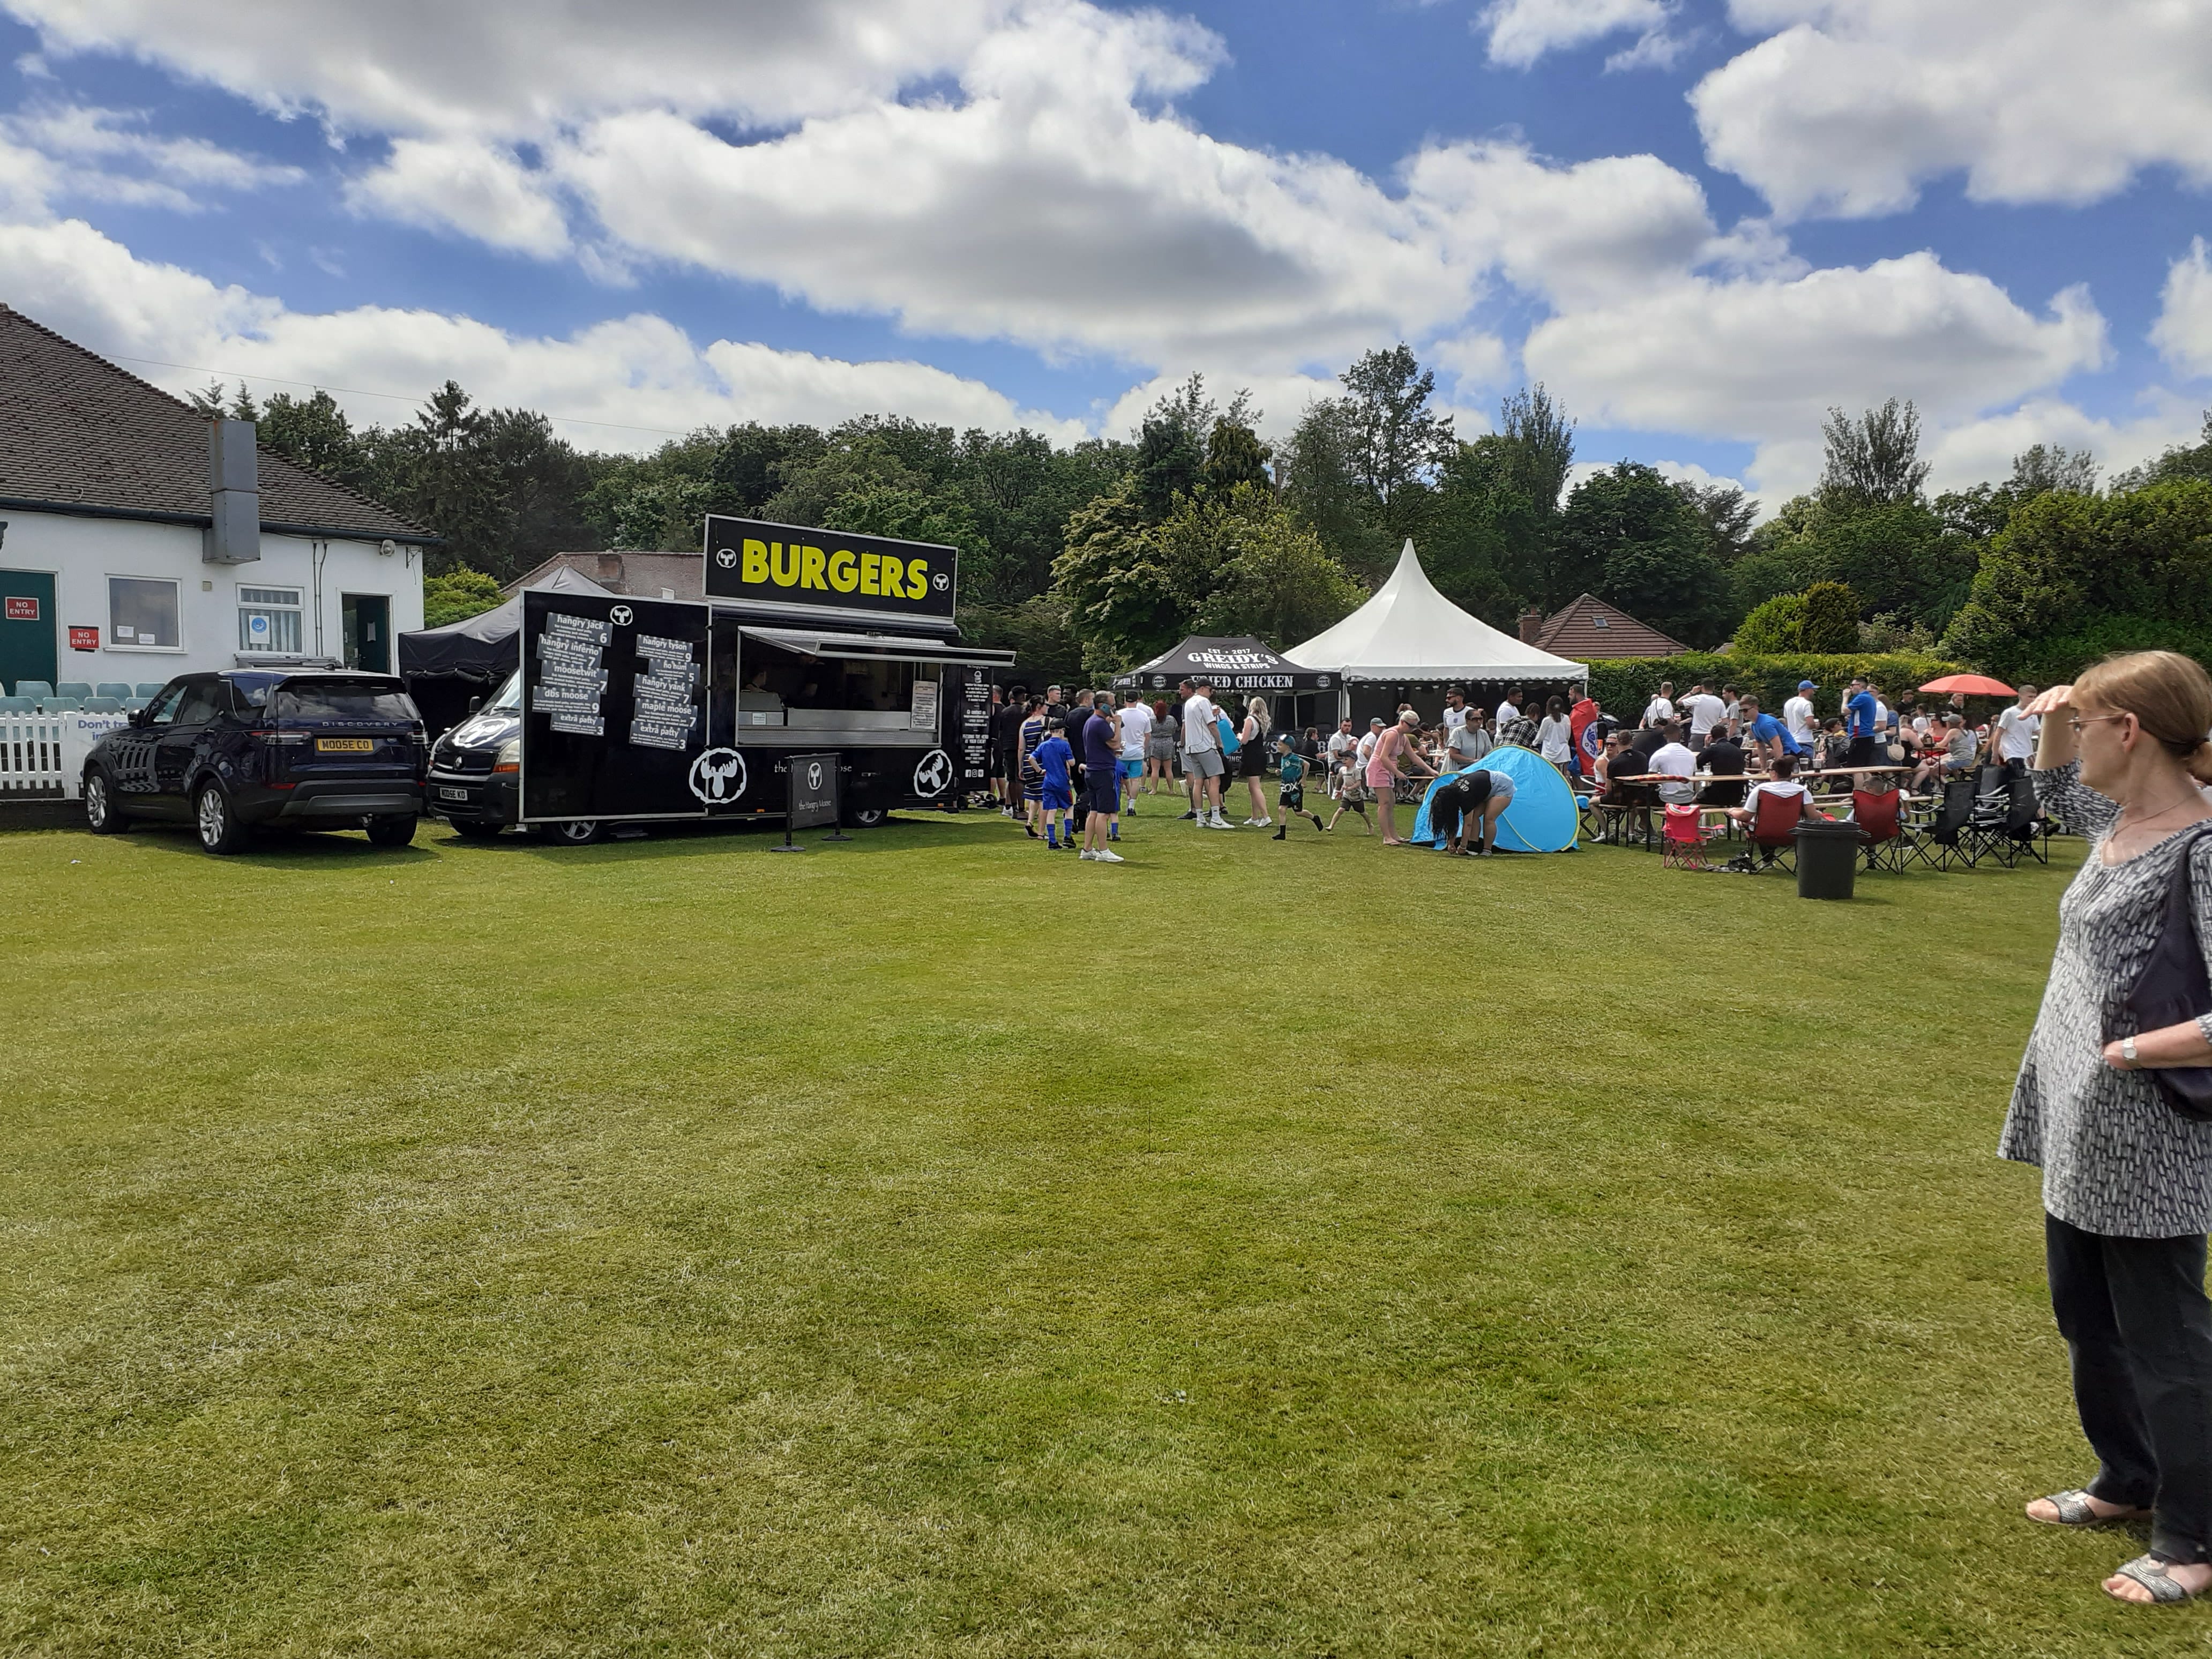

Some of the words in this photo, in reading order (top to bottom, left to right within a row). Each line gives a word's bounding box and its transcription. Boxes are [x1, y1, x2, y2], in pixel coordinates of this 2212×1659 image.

[742, 539, 928, 600] BURGERS
[557, 615, 585, 628] hangry
[587, 620, 604, 630] jack
[600, 633, 607, 644] 6
[642, 637, 668, 648] hangry
[668, 640, 687, 651] tyson
[541, 636, 570, 650] hangry
[571, 642, 599, 655] inferno
[588, 656, 595, 667] 7
[685, 653, 692, 662] 9
[554, 666, 597, 677] moosetwit
[672, 662, 687, 670] hum
[688, 672, 694, 682] 5
[1191, 675, 1231, 687] FIED
[1235, 675, 1294, 688] CHICKEN
[600, 681, 607, 691] 7
[642, 677, 668, 689] hangry
[668, 682, 685, 692] yank
[544, 689, 559, 698] dbs
[683, 694, 690, 704] 7
[592, 703, 600, 714] 9
[642, 703, 666, 712] maple
[667, 706, 692, 715] moose
[78, 720, 110, 729] Don't
[579, 715, 596, 725] patty
[690, 717, 696, 727] 7
[597, 727, 604, 735] 3
[640, 725, 659, 734] extra
[660, 727, 679, 738] patty
[679, 739, 686, 749] 3
[774, 760, 787, 773] the
